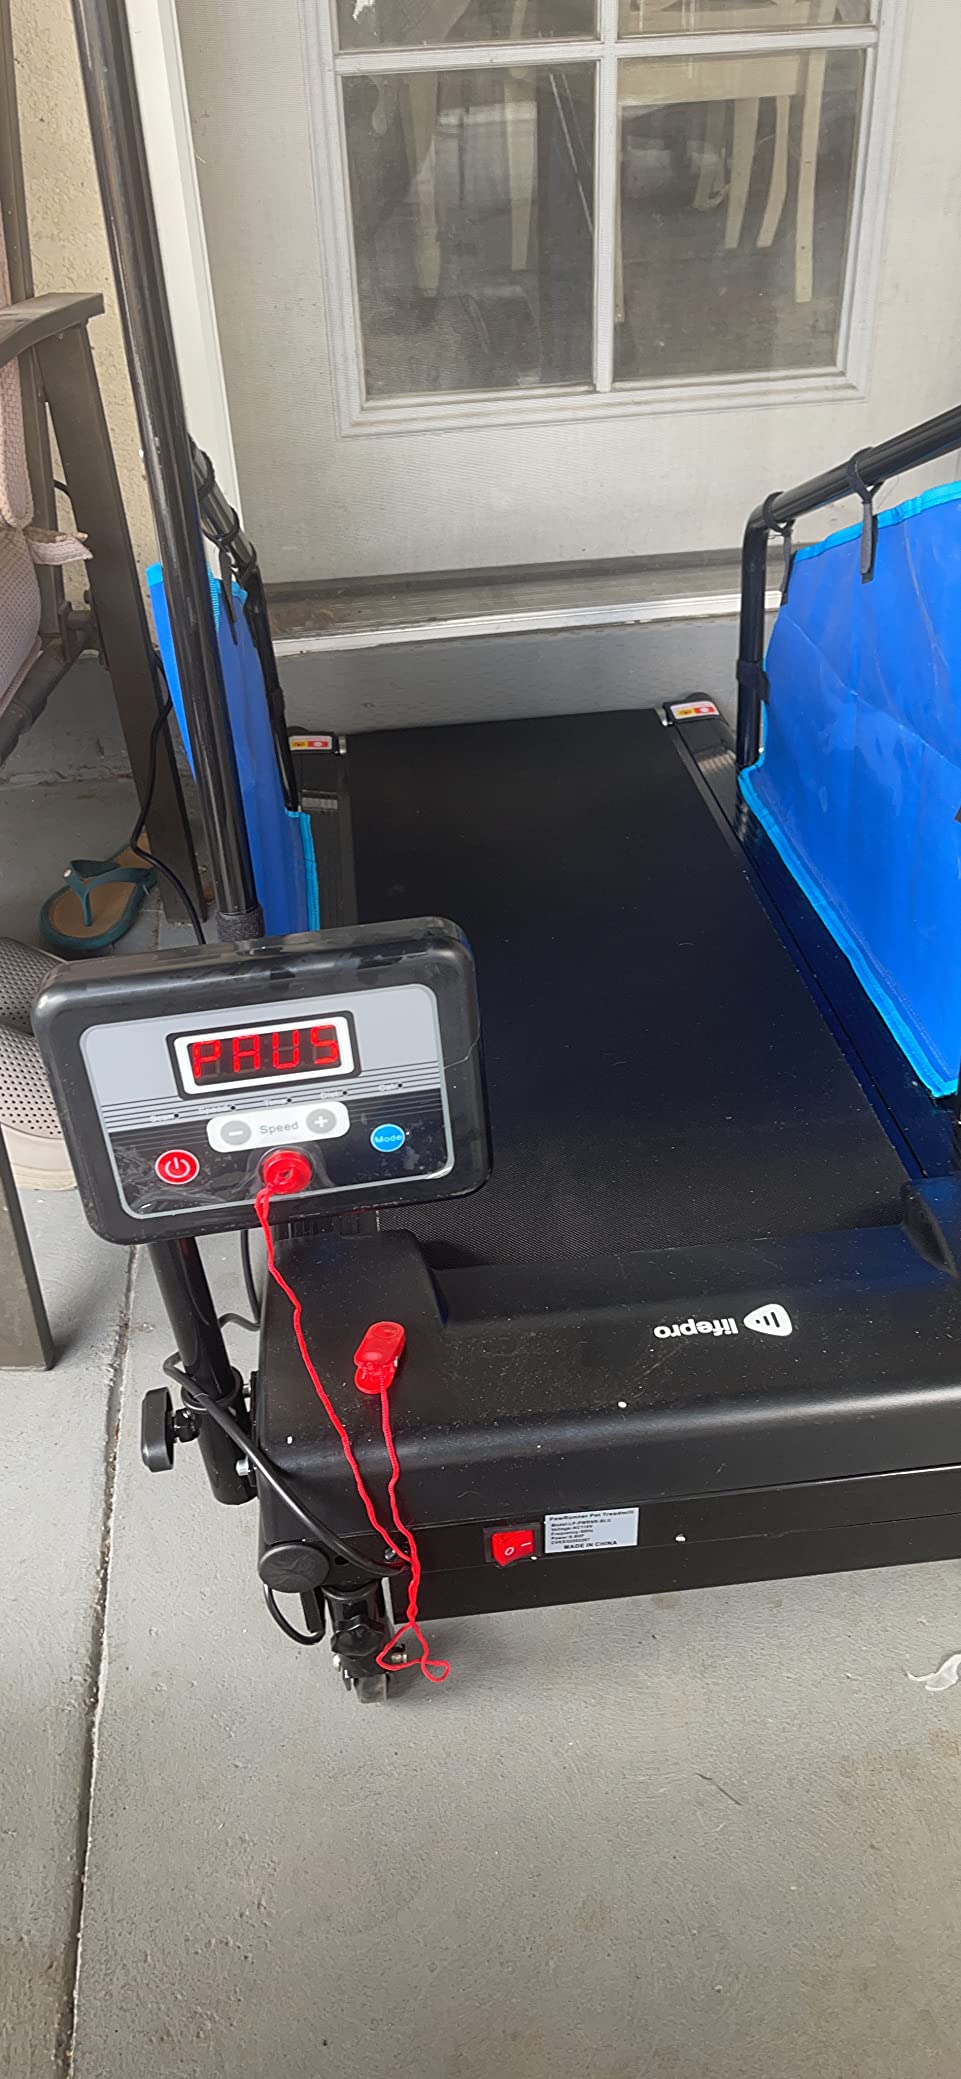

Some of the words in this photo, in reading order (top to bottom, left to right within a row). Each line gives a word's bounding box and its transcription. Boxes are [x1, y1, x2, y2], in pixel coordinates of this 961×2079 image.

[192, 1024, 340, 1079] PAUS
[260, 1121, 299, 1136] Speed
[375, 1134, 403, 1143] Mode
[653, 1317, 739, 1339] lifepro
